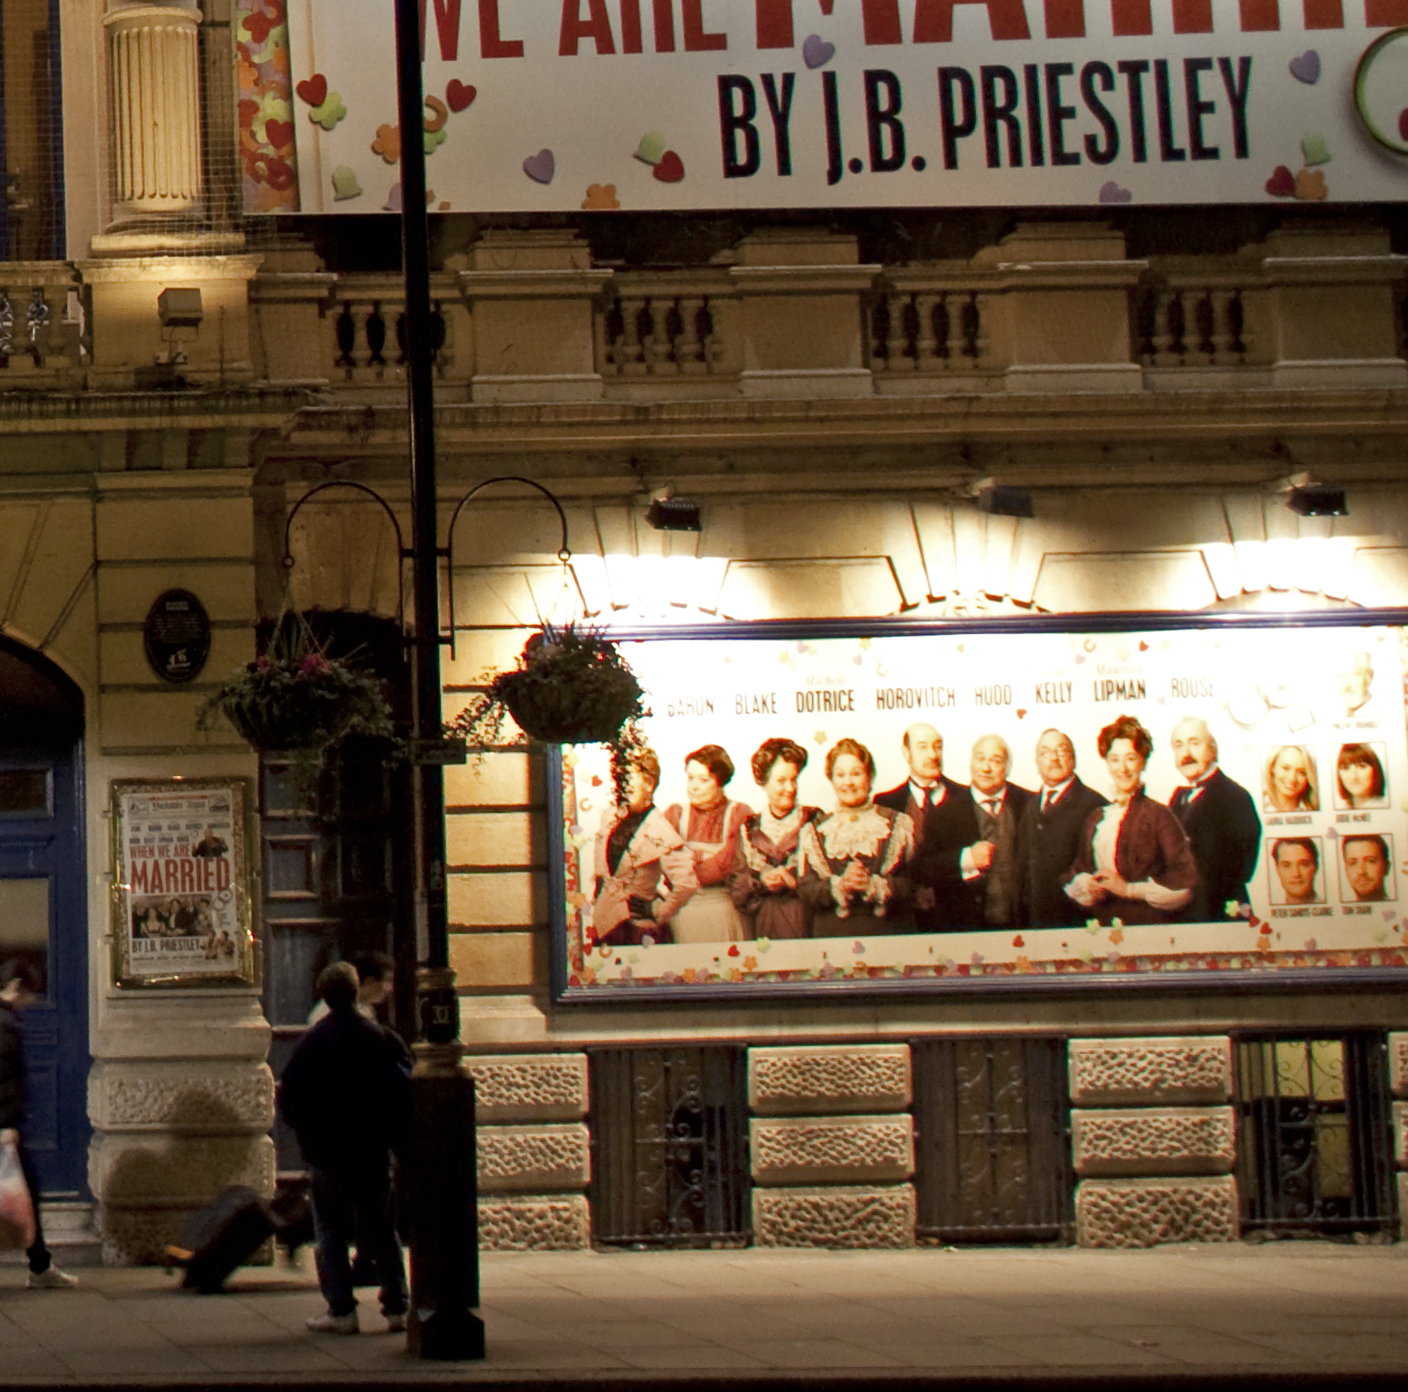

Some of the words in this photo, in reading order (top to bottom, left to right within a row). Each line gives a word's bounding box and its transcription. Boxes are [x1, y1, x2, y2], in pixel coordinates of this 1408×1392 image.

[716, 71, 796, 179] BY
[820, 69, 927, 186] J.B.
[936, 55, 1253, 170] PRIESTLEY
[667, 694, 714, 717] BARON
[734, 692, 778, 715] BLAKE
[795, 689, 856, 713] DOTRICE
[876, 686, 956, 710] HOROVITCH
[975, 684, 1012, 707] HUDD
[1034, 680, 1073, 705] KELLY
[1093, 678, 1147, 703] LIPMAN
[1170, 675, 1215, 699] ROUSE
[129, 845, 155, 859] WHEN
[157, 844, 173, 858] WE
[173, 843, 190, 858] ARE
[130, 857, 230, 894] MARRIED
[160, 938, 201, 952] PRIESTLEY
